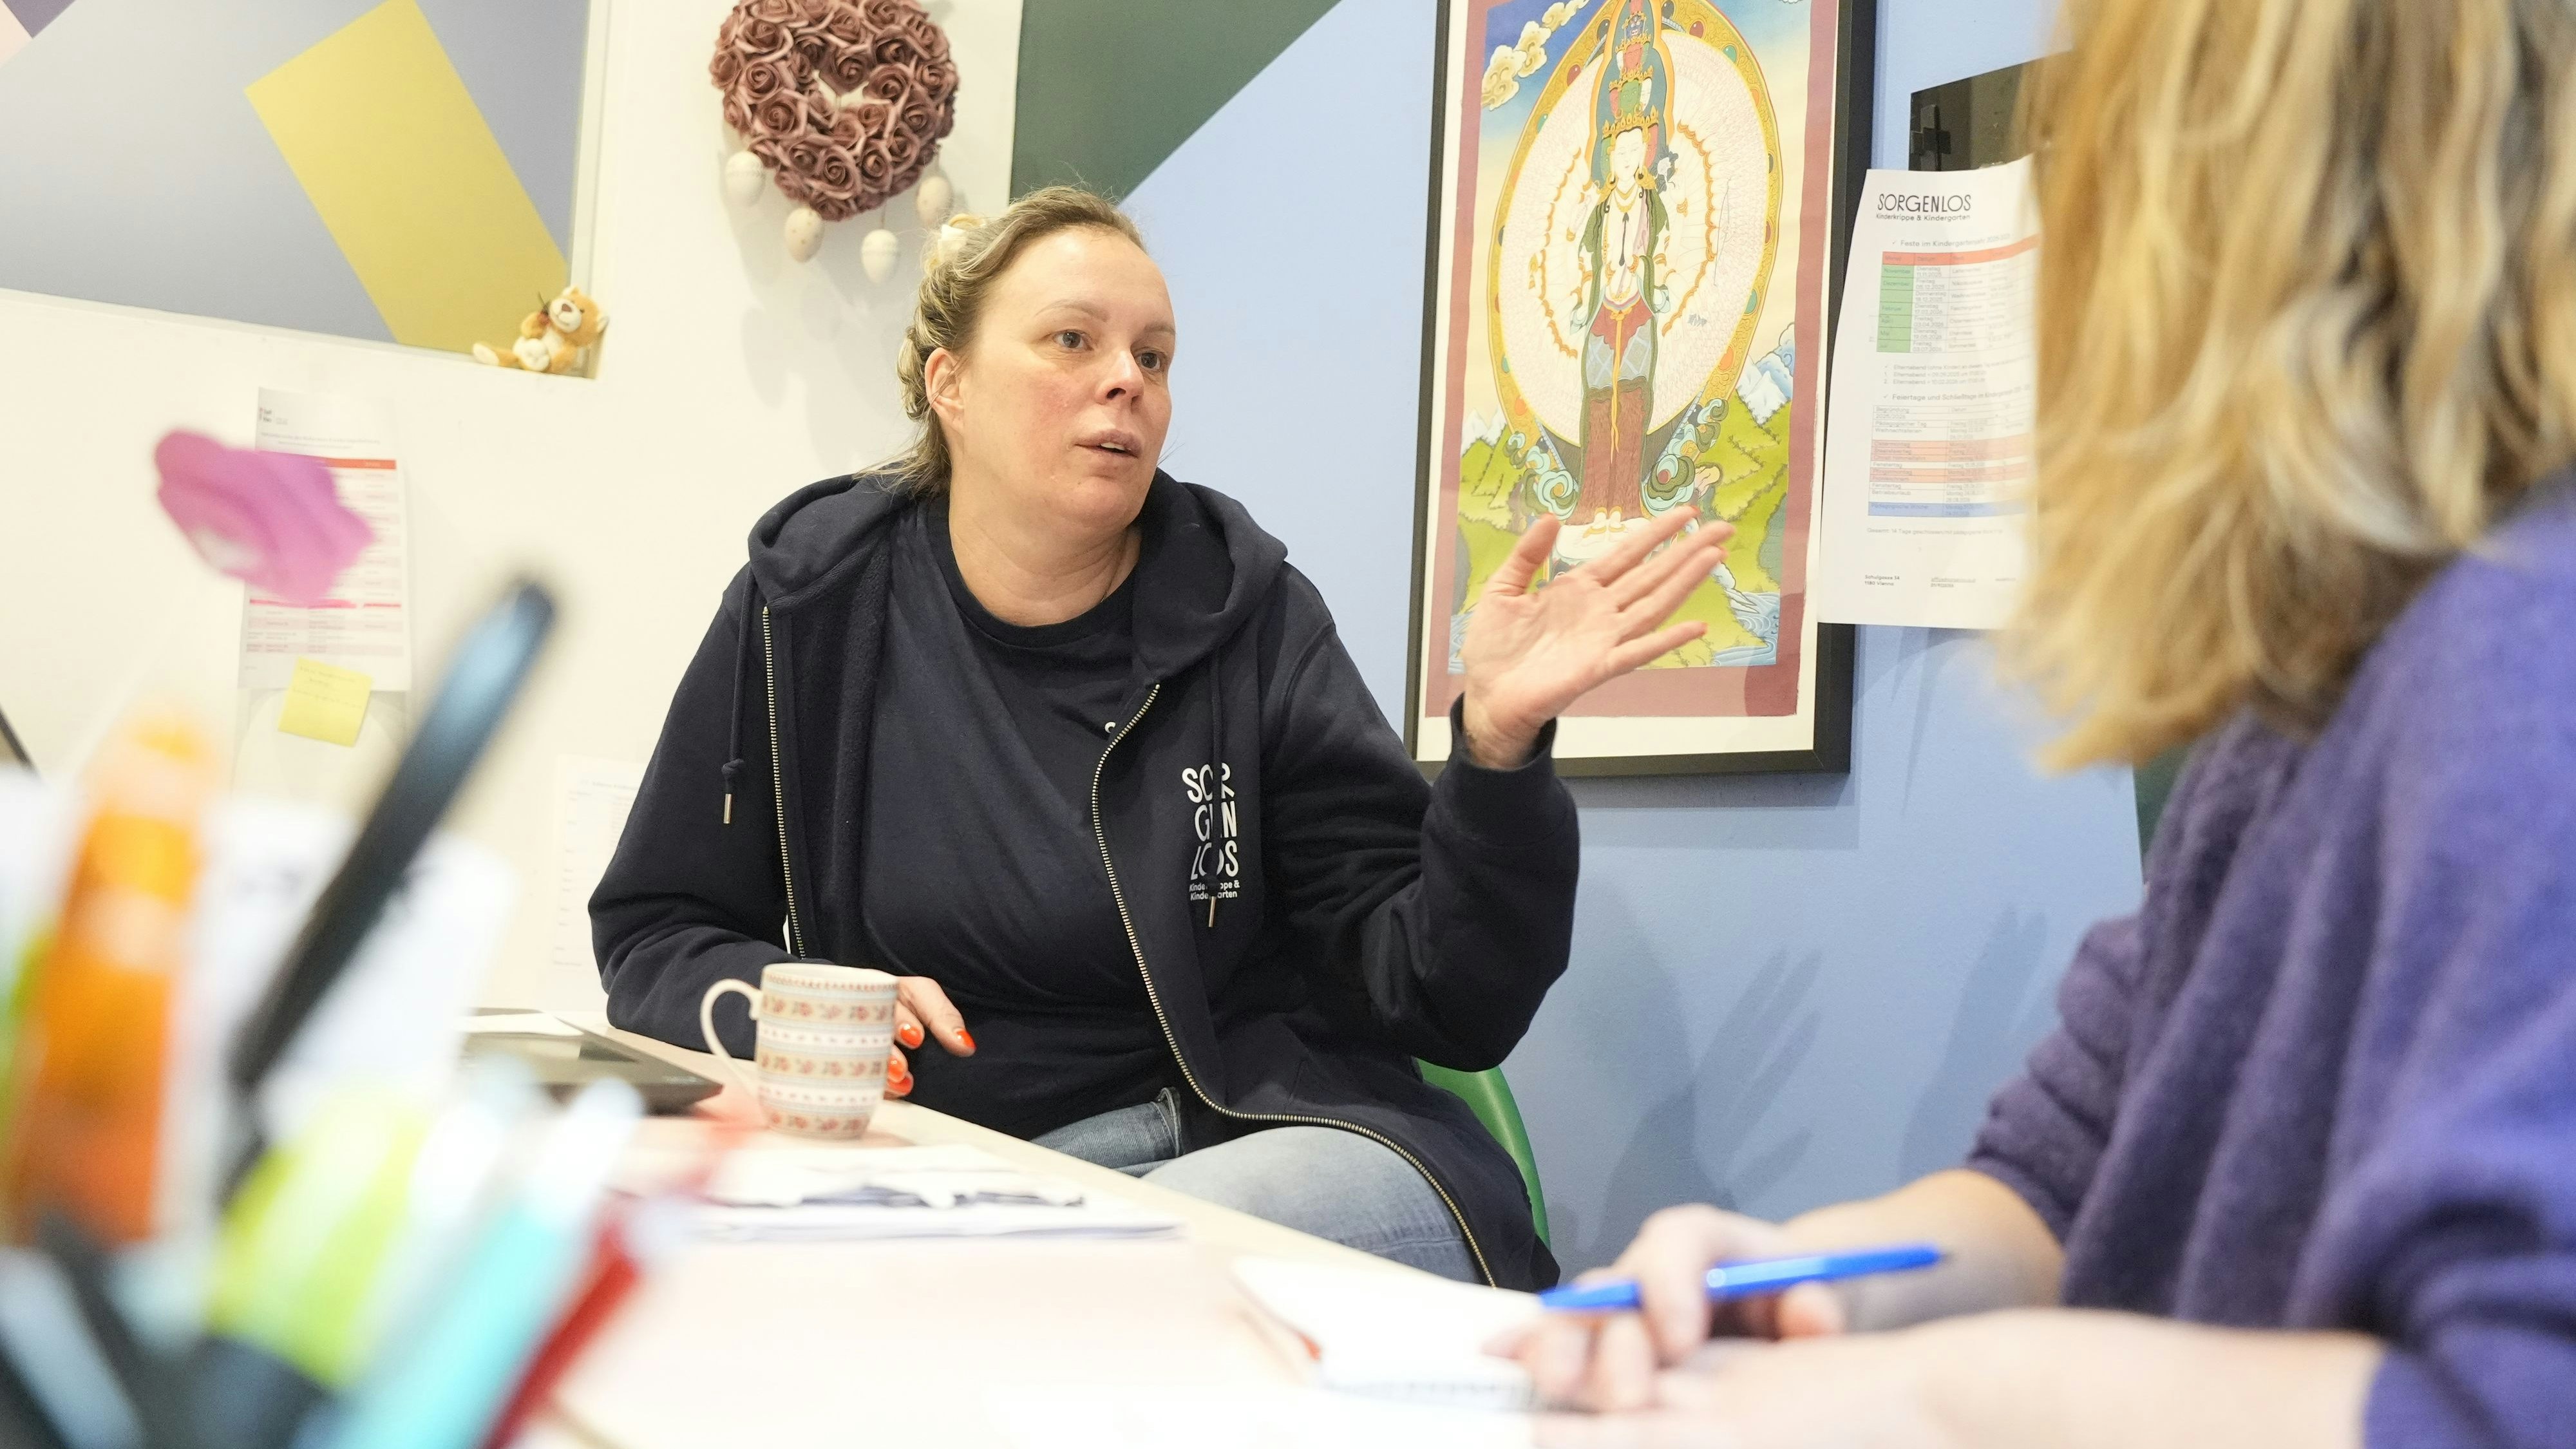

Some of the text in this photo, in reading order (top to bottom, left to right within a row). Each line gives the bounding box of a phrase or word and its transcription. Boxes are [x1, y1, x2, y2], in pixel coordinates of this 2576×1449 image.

[1878, 193, 1971, 212] SORGENLOS
[1234, 880, 1240, 888] &
[1191, 891, 1238, 900] Kindearten
